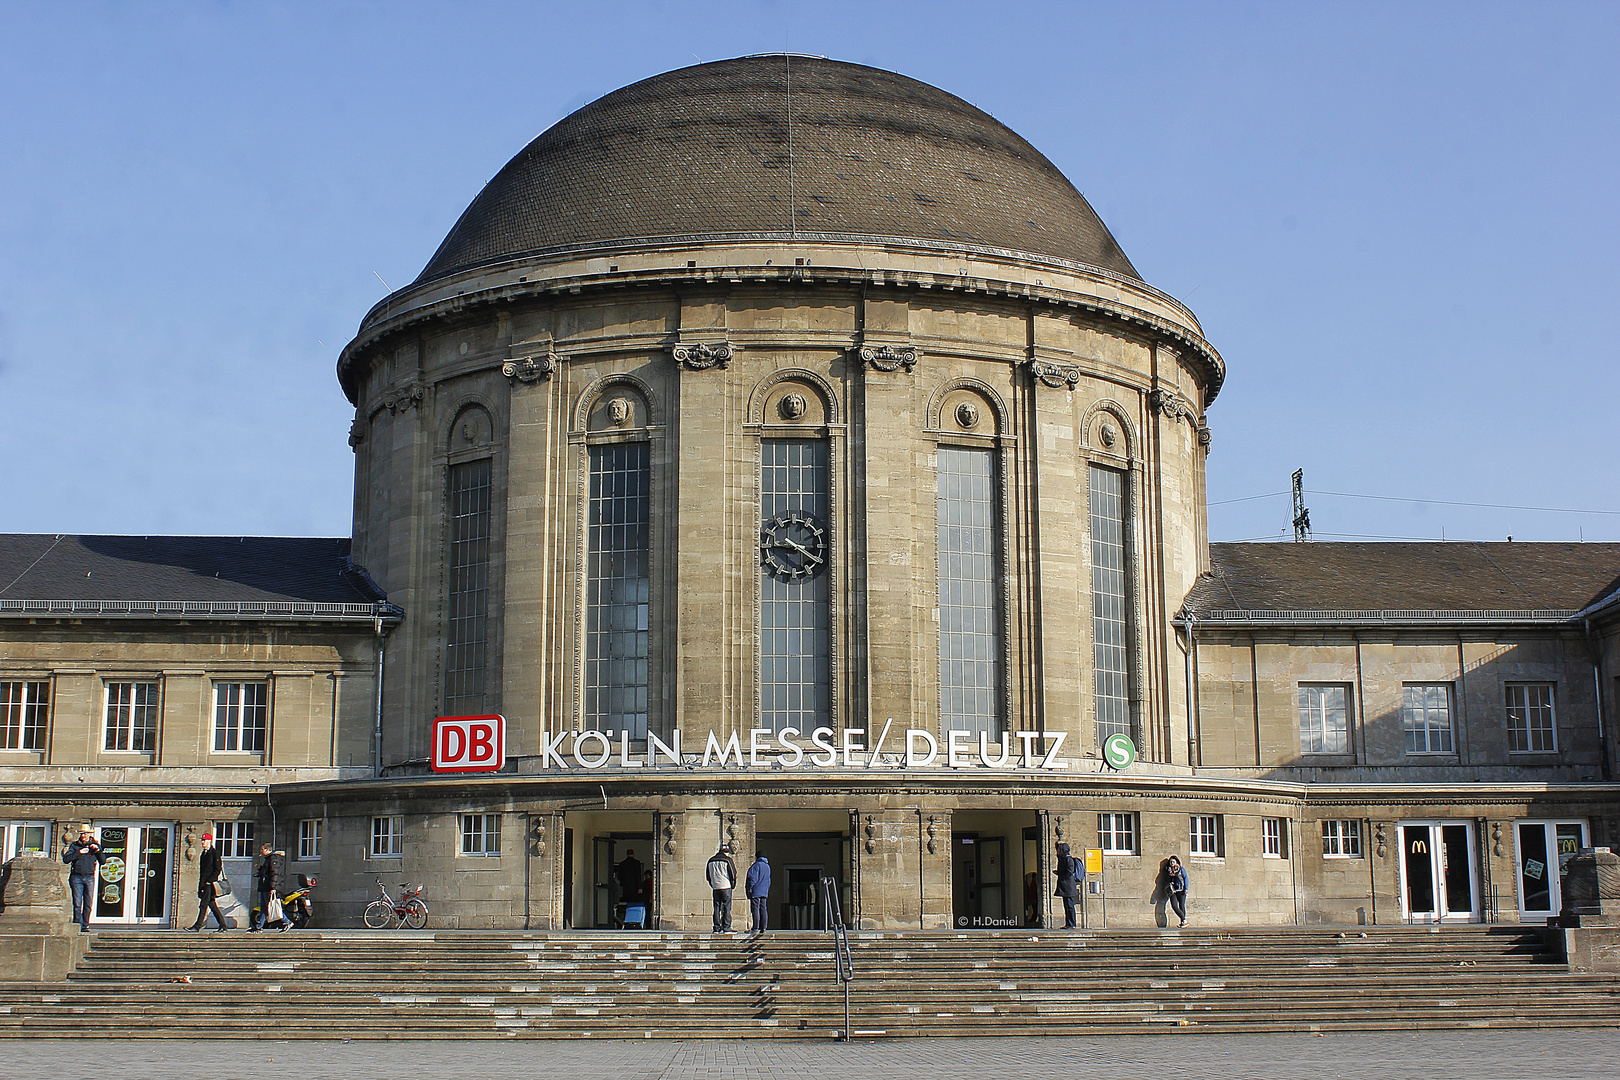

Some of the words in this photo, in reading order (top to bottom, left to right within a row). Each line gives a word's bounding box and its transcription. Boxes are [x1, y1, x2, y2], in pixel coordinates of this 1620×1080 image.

[441, 724, 494, 763] DB
[543, 729, 682, 769] KÖLN
[702, 717, 1069, 769] MESSE/DEUTZ
[1111, 738, 1130, 765] S
